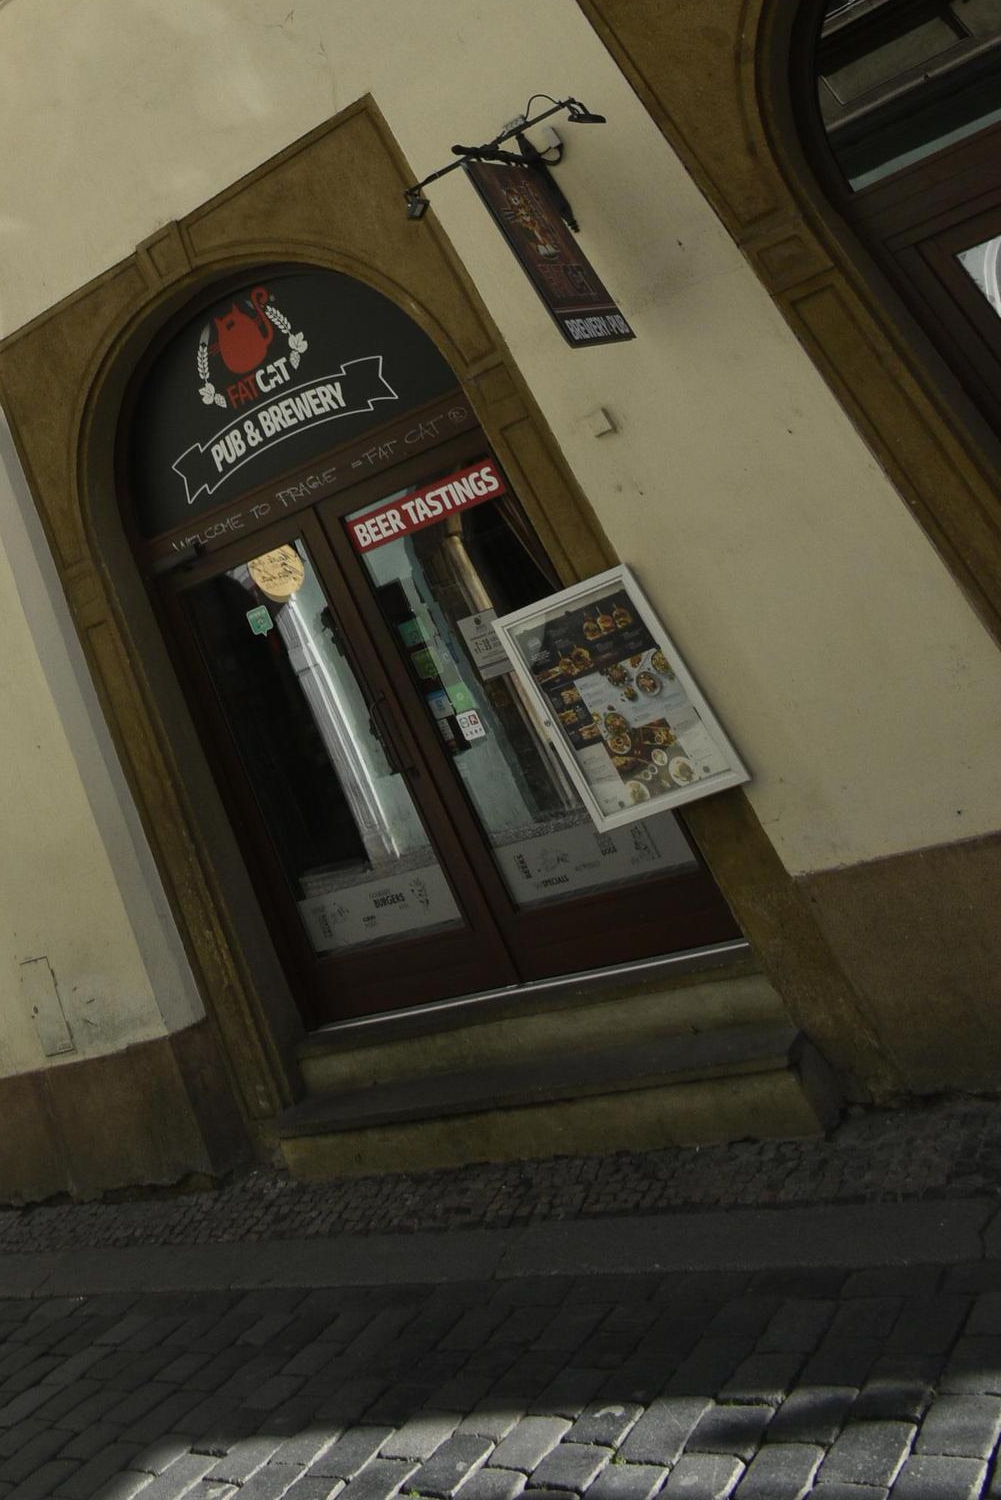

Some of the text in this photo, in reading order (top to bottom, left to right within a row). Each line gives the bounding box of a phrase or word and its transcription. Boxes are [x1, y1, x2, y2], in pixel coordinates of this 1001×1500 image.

[210, 381, 347, 473] PUB & BREWERY
[172, 512, 245, 551] WELCOME
[250, 502, 272, 520] TO
[274, 467, 337, 508] PRAGUE
[403, 414, 444, 445] CAT
[353, 466, 500, 548] BEER TASTINGS
